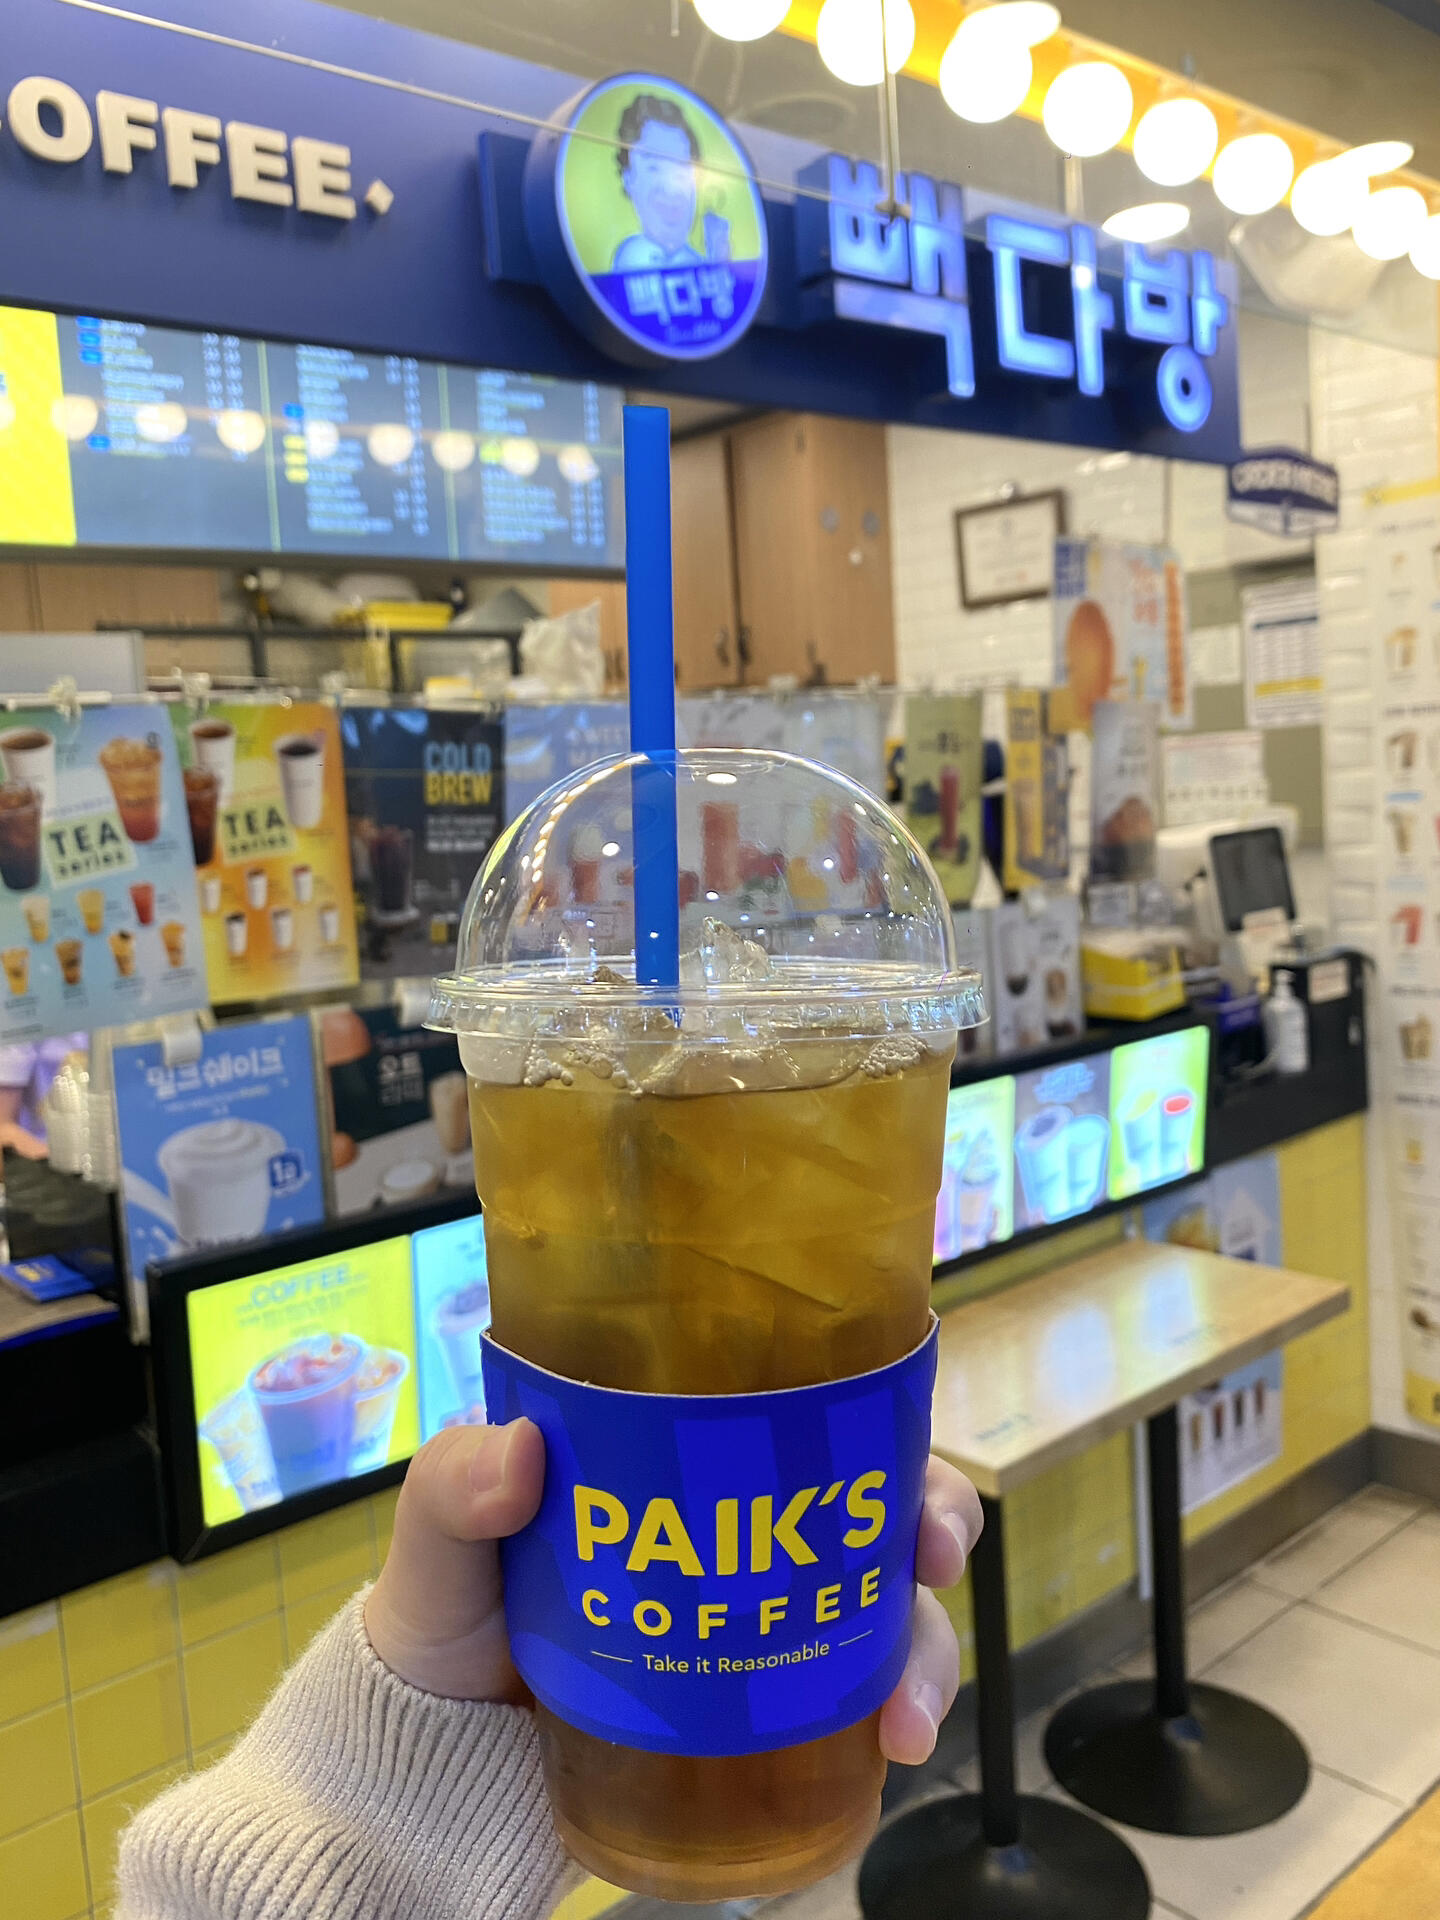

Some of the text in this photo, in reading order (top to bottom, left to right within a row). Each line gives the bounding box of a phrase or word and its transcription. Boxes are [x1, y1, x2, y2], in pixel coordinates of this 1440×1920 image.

[0, 76, 356, 219] OFFEE
[829, 153, 1228, 432] 빽다방
[424, 741, 492, 773] COLD
[425, 772, 492, 805] BREW
[49, 819, 120, 857] TEA
[224, 806, 285, 838] TEA
[230, 834, 287, 856] series
[58, 850, 126, 878] series
[573, 1470, 886, 1577] PAIK'S
[582, 1567, 881, 1639] COFFEE
[643, 1641, 830, 1673] Take it Reasonable
